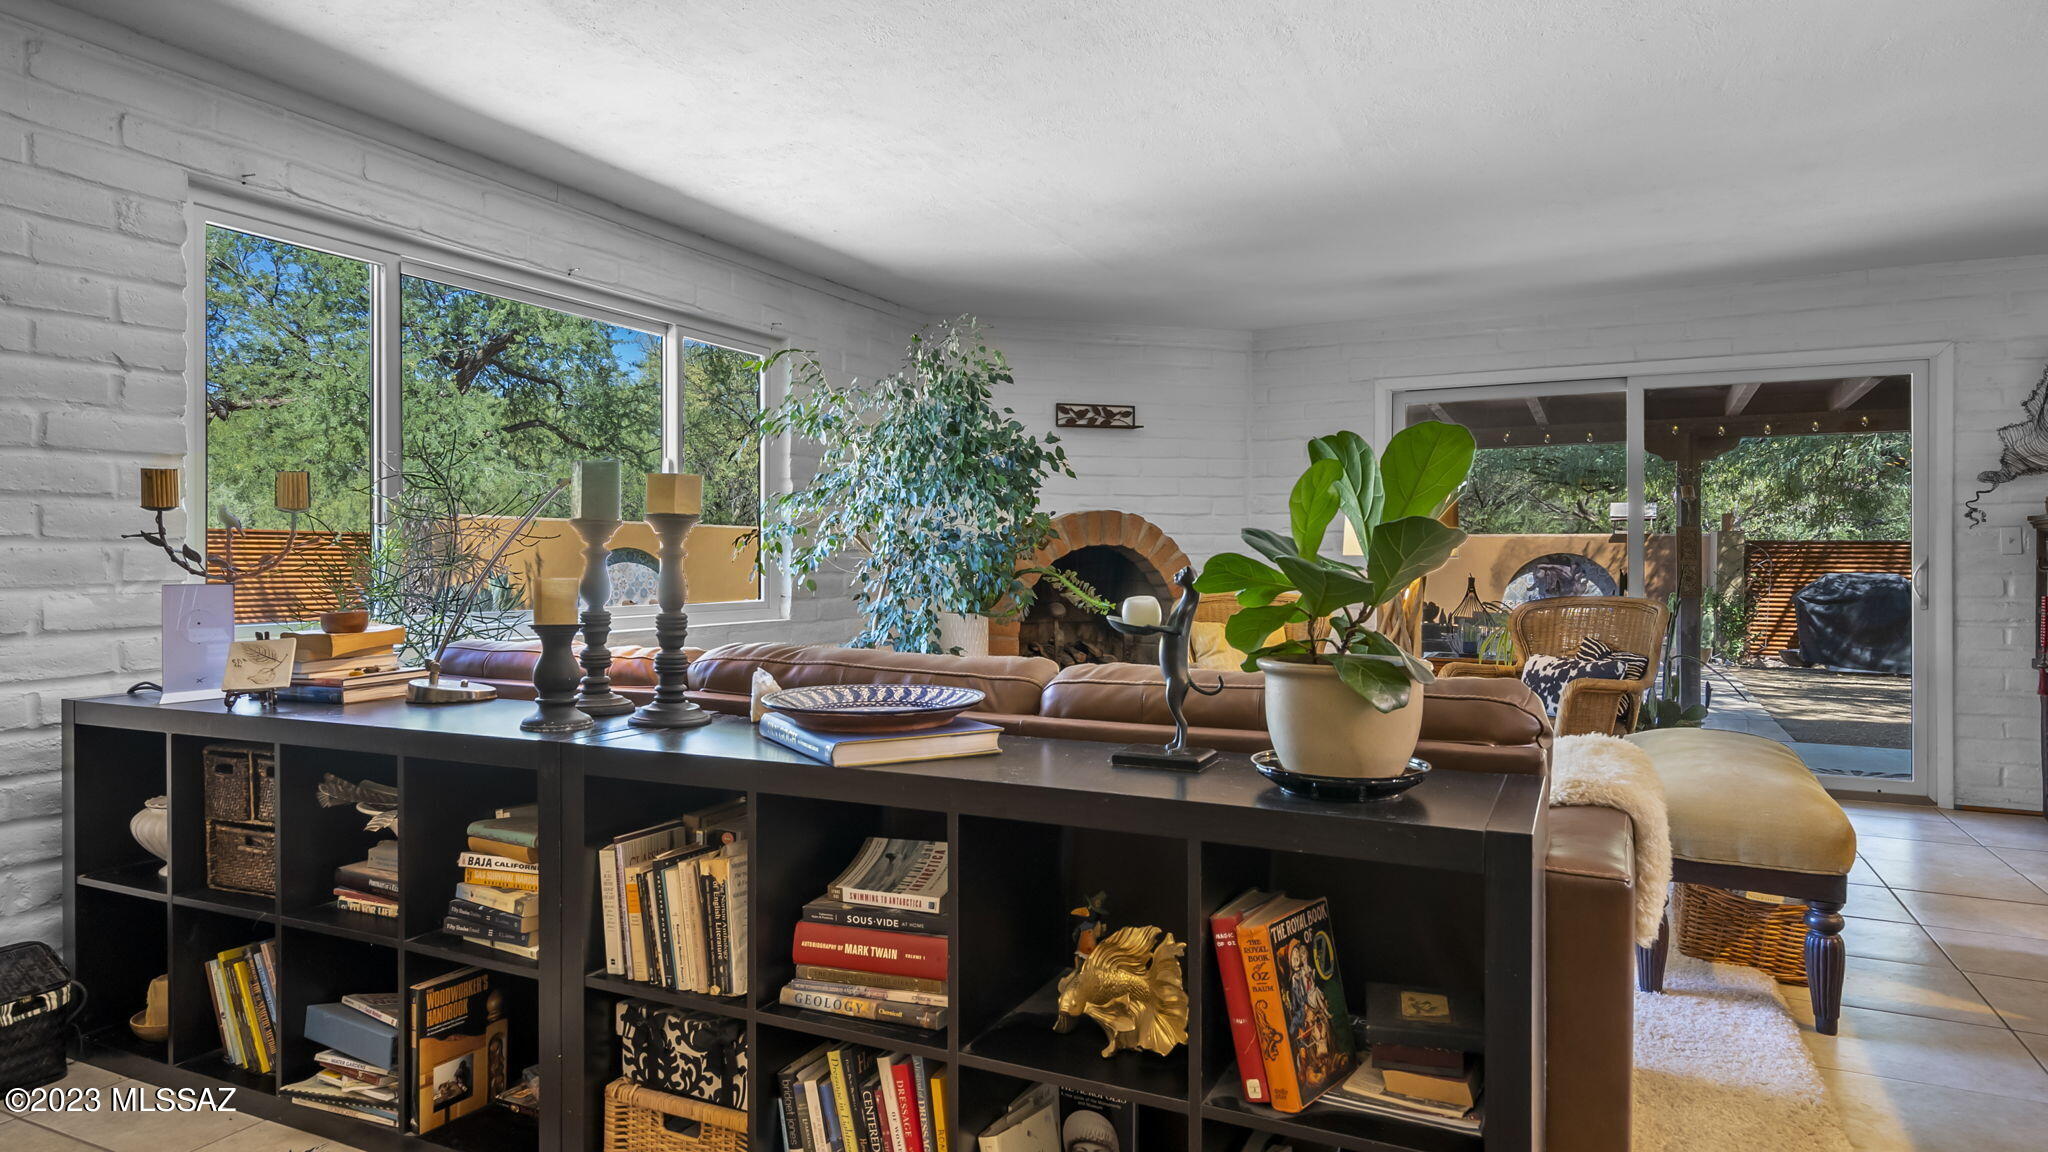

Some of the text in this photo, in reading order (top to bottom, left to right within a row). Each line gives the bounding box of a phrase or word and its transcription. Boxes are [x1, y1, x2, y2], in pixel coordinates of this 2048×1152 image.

[467, 856, 492, 868] BAJA
[849, 892, 879, 903] SWIMMING
[881, 895, 888, 904] TO
[889, 896, 922, 908] ANTARCTICA
[712, 880, 723, 960] of English Literature
[1270, 903, 1328, 944] THE ROYAL BOOK
[1216, 932, 1234, 940] MAGIC
[1304, 928, 1313, 944] OF
[801, 941, 837, 951] AUTOBIOGRAPHY
[844, 944, 869, 957] MARK
[870, 946, 898, 960] TWAIN
[1244, 946, 1269, 954] ROYAL
[1248, 955, 1271, 963] BOOK
[1252, 971, 1271, 981] OZ
[427, 974, 489, 1010] WOODWORKER'S
[427, 998, 469, 1028] HANDBOOK
[794, 992, 865, 1015] GEOLOGY
[783, 1080, 797, 1146] bridget jones
[896, 1080, 913, 1138] DRESSAGE
[863, 1091, 881, 1152] CENTERED
